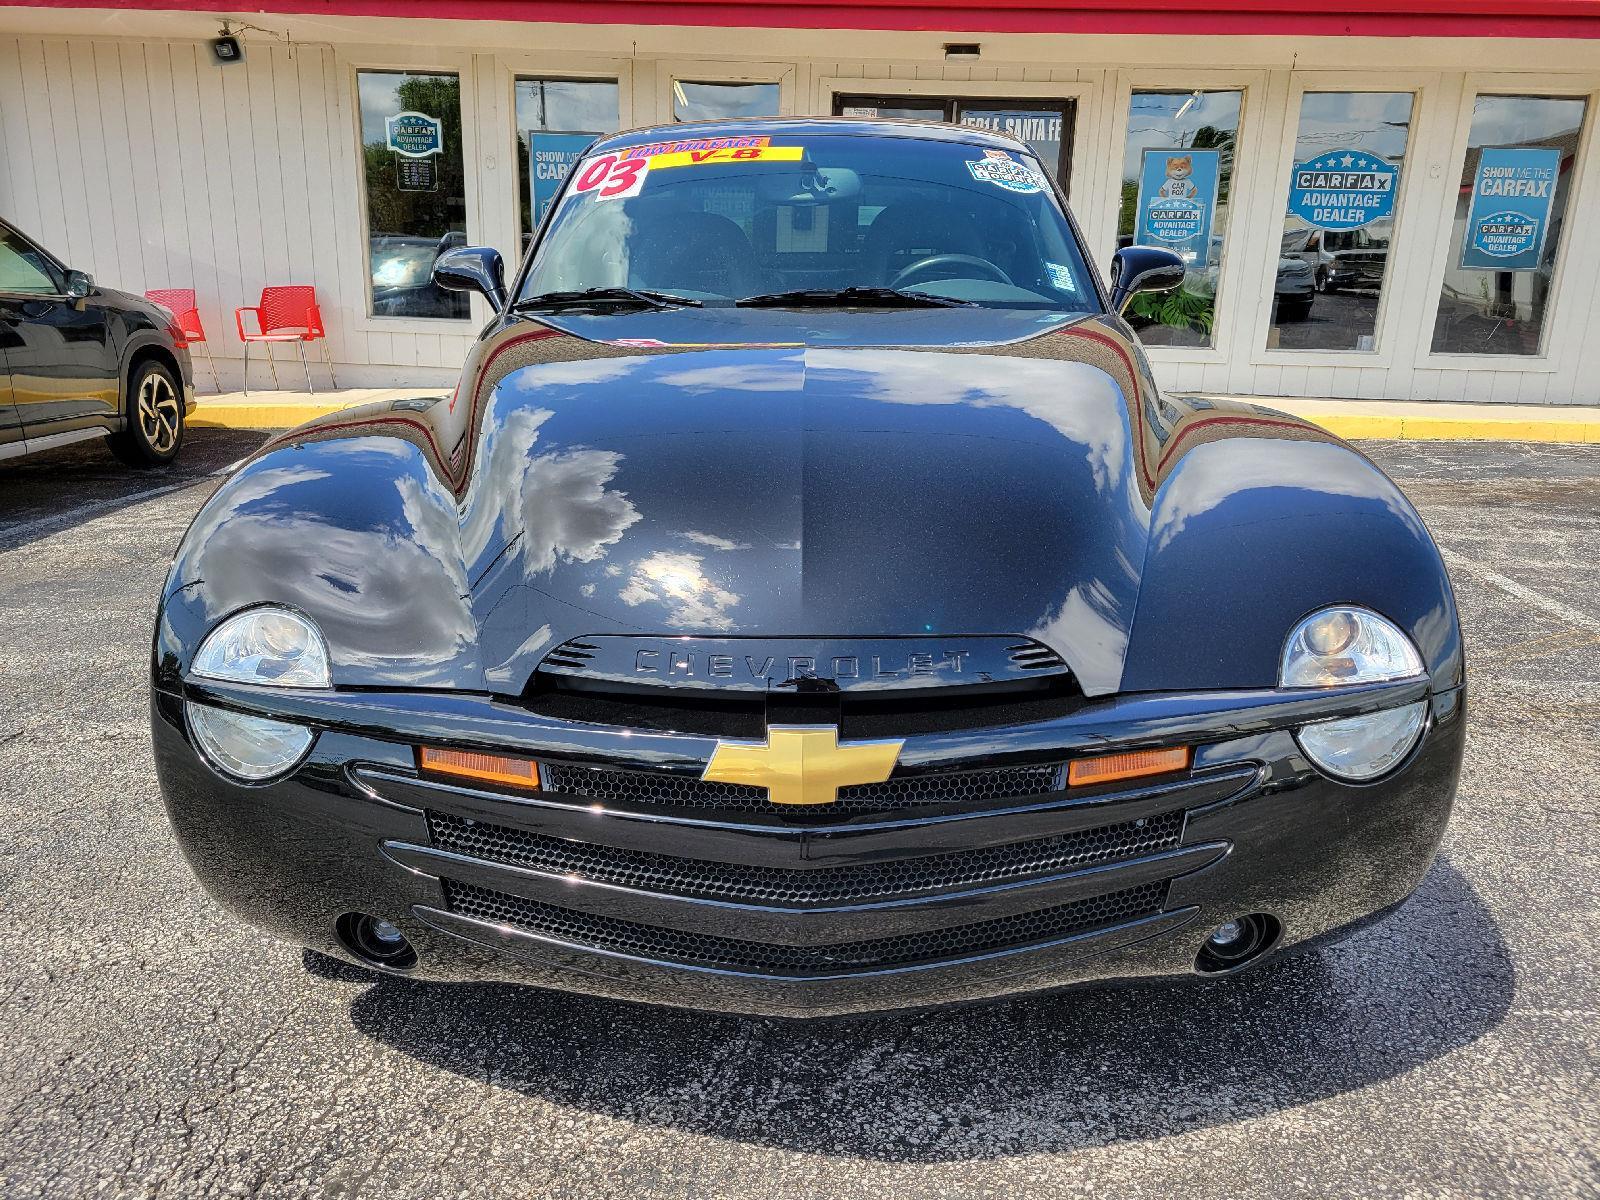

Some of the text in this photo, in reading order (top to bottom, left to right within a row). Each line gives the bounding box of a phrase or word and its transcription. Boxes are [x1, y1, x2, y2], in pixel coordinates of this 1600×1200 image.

[393, 126, 435, 135] CARFAX
[1005, 118, 1045, 140] SANTA
[1049, 118, 1062, 141] FE
[397, 136, 432, 144] ADVANTAGE
[627, 138, 762, 159] LOW MILEAGE
[536, 151, 564, 162] SHOW
[691, 149, 762, 162] V-8
[537, 163, 574, 180] CAR
[577, 156, 646, 197] 03
[1483, 166, 1552, 179] SHOW ME THE
[1171, 182, 1185, 190] CAR
[1300, 174, 1389, 190] CARFAX
[1480, 178, 1551, 197] CARFAX
[1301, 193, 1381, 207] ADVANTAGE
[1152, 211, 1198, 219] CARFAX
[1313, 208, 1365, 222] DEALER
[1153, 221, 1196, 229] ADVANTAGE
[1482, 225, 1531, 235] CARFAX
[1482, 235, 1527, 243] ADVANTAGE
[636, 650, 969, 679] CHEVROLET
